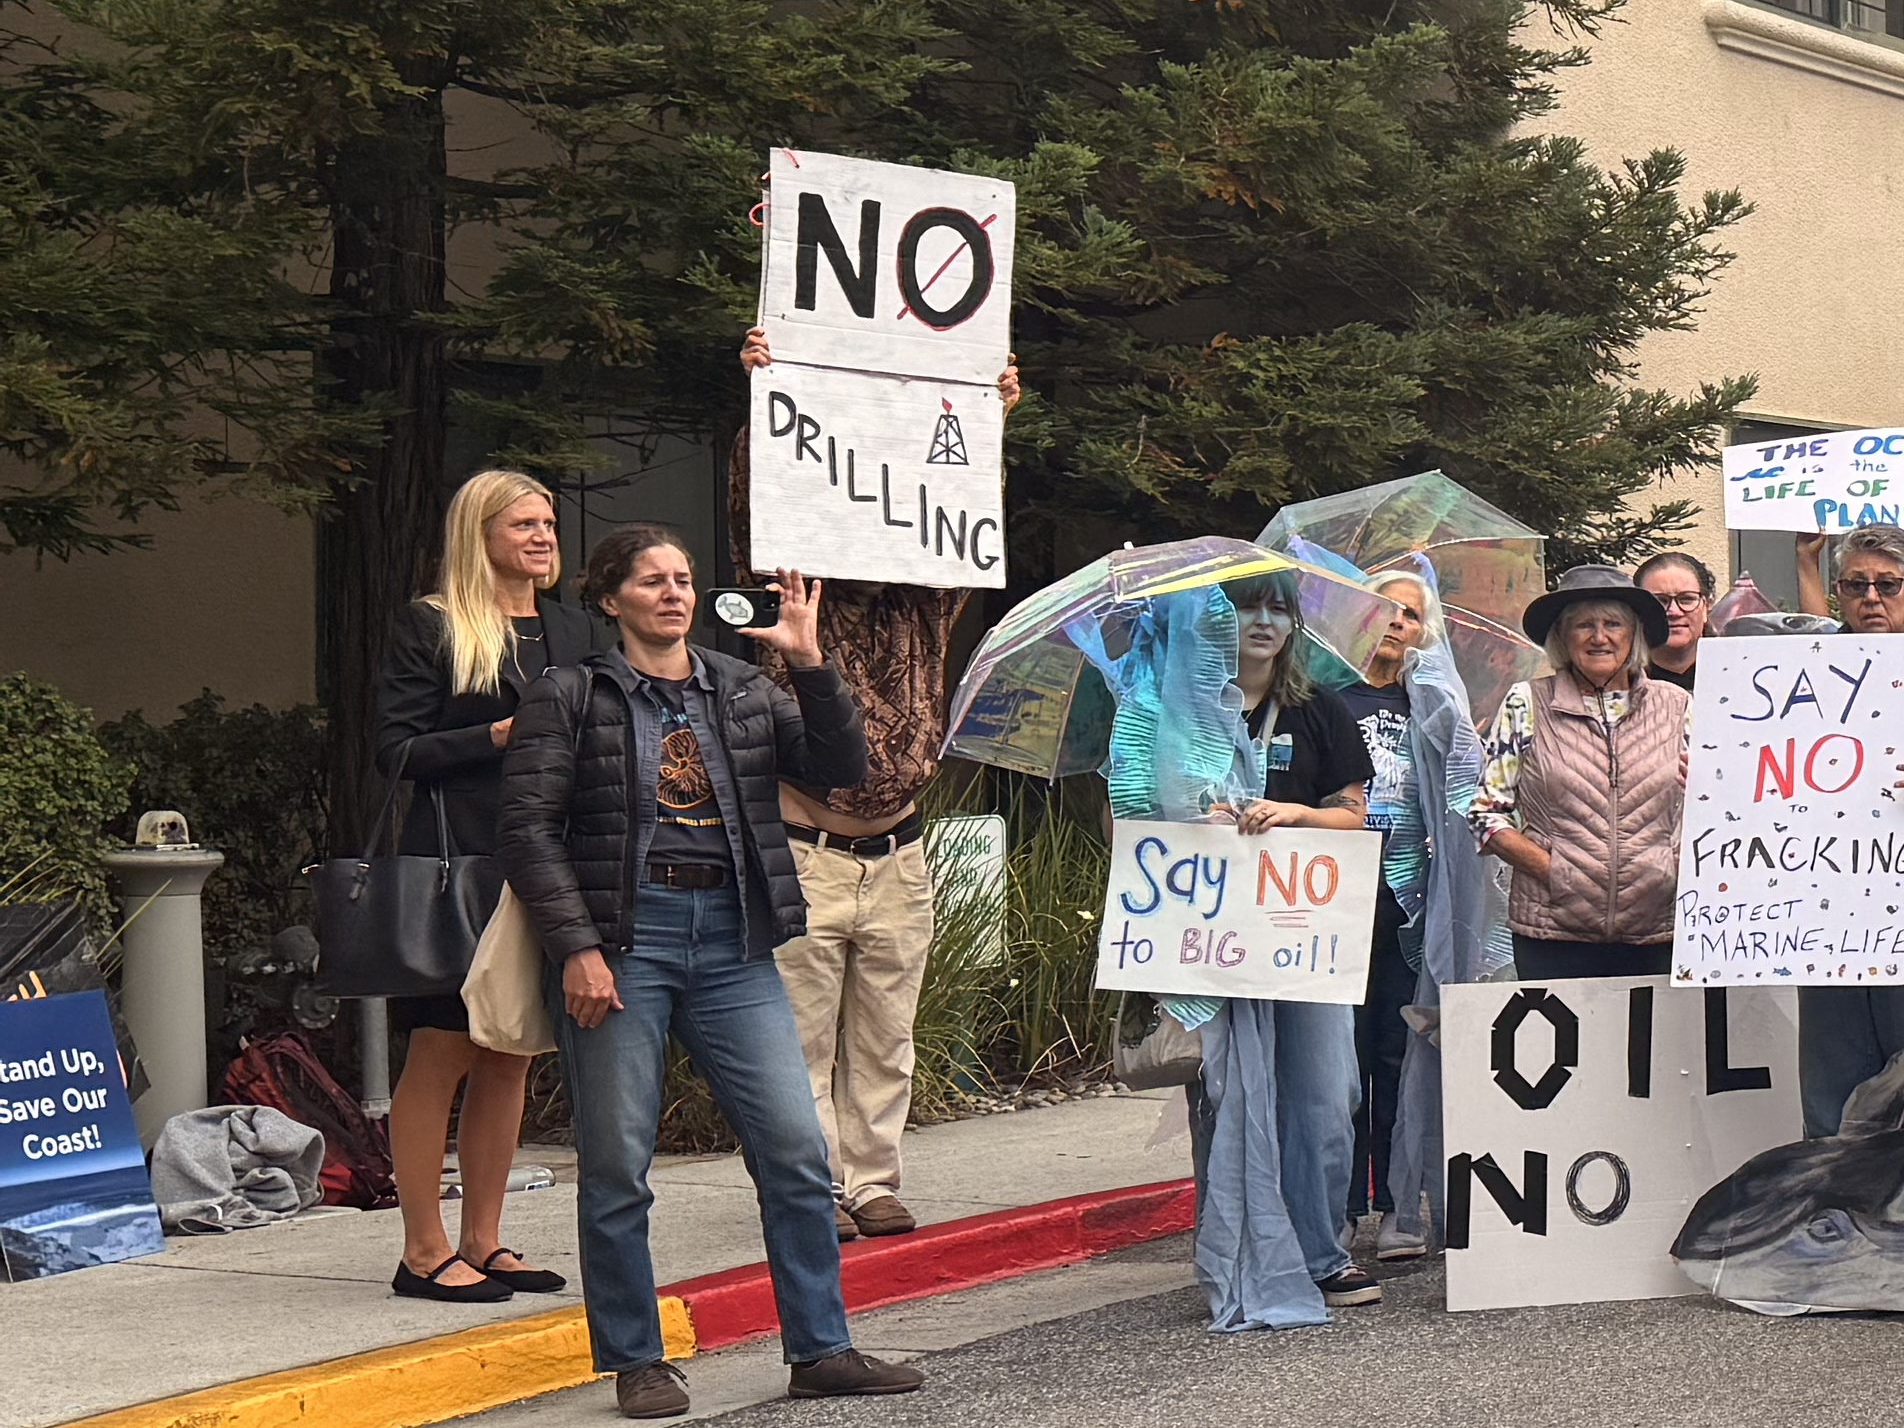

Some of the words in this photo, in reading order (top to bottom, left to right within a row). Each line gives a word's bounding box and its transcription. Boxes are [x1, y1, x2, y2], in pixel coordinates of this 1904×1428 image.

[795, 191, 995, 331] NO
[1756, 438, 1830, 463] THE
[1850, 459, 1888, 473] the
[768, 390, 1000, 570] DRILLING
[1742, 479, 1817, 502] LIFE
[1847, 479, 1889, 497] OF
[1730, 658, 1873, 724] SAY
[1753, 733, 1864, 803] NO
[1789, 804, 1808, 813] TO
[1118, 836, 1228, 920] Say
[1256, 849, 1340, 907] NO
[1677, 890, 1804, 928] PROTECT
[1110, 920, 1154, 970] to
[1179, 927, 1246, 968] BIG
[1273, 933, 1339, 975] oil!
[1700, 925, 1825, 962] MARINE
[0, 1051, 57, 1084] tand
[60, 1047, 105, 1077] Up,
[1490, 986, 1772, 1110] OIL
[0, 1095, 57, 1124] Save
[62, 1087, 108, 1114] Our
[22, 1124, 103, 1160] Coast!
[1446, 1149, 1631, 1250] NO
